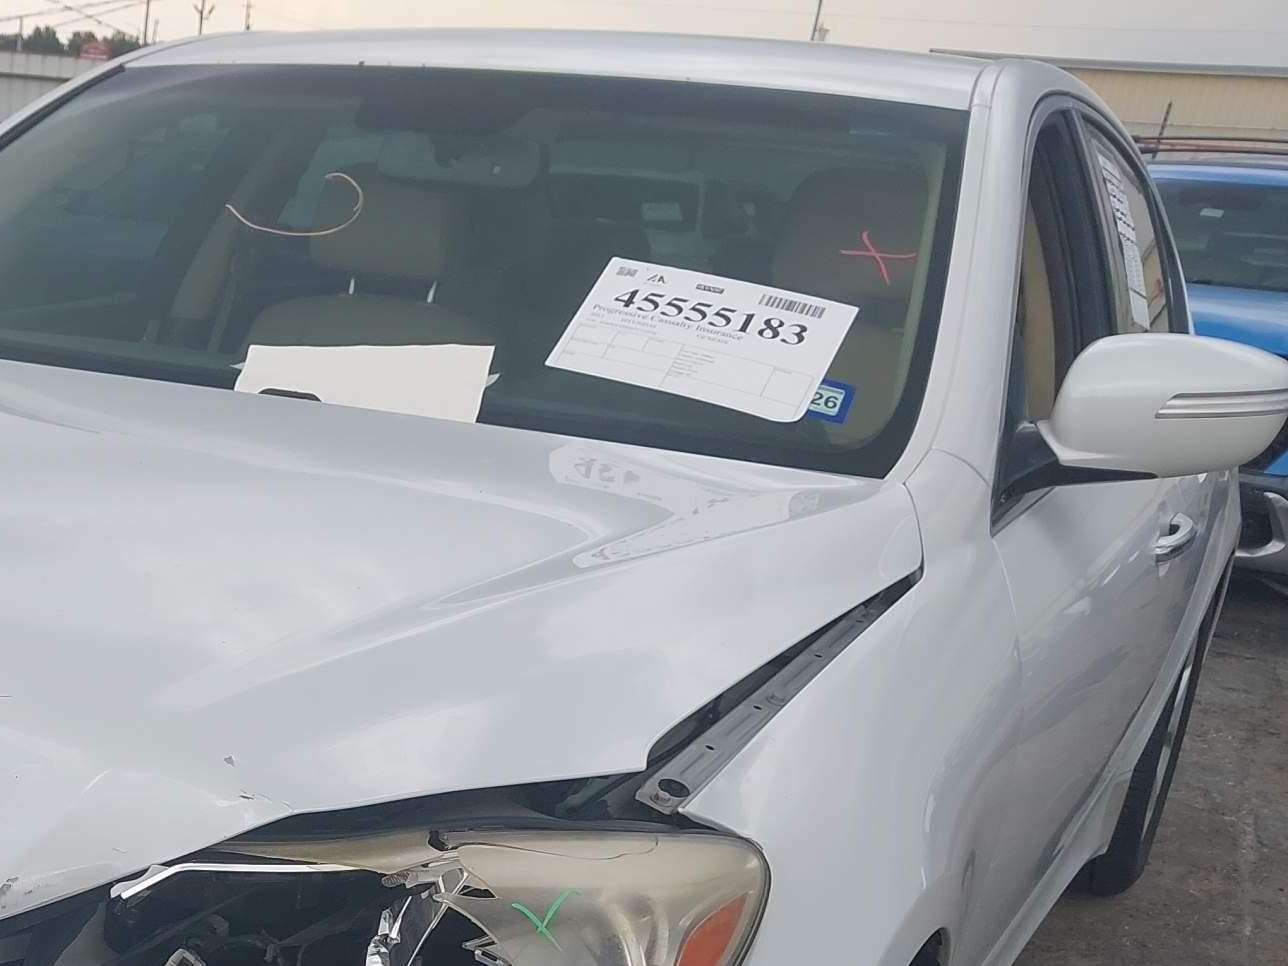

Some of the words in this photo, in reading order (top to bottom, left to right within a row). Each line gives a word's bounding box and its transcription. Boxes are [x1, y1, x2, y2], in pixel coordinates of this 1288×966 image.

[593, 303, 648, 320] Progressive
[650, 313, 692, 330] Casualty
[696, 323, 744, 341] Insurance
[614, 288, 809, 346] 45555183
[810, 391, 839, 410] 26
